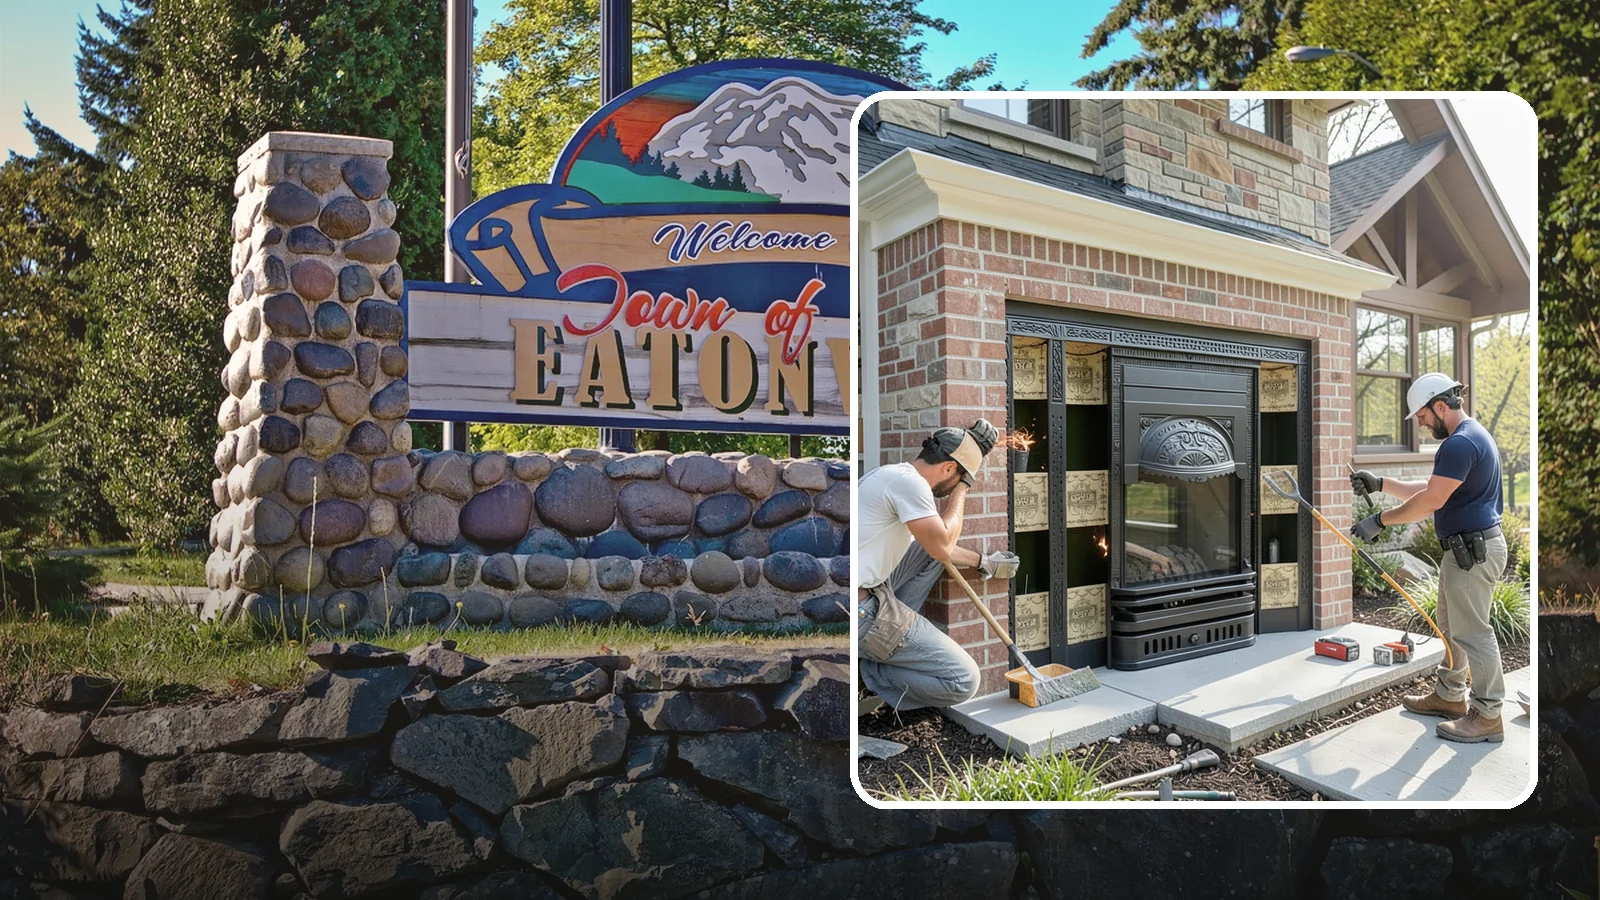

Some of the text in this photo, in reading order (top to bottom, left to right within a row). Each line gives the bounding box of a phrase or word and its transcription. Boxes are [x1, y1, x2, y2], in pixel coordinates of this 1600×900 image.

[653, 221, 836, 263] Welcome
[556, 263, 826, 365] Town of
